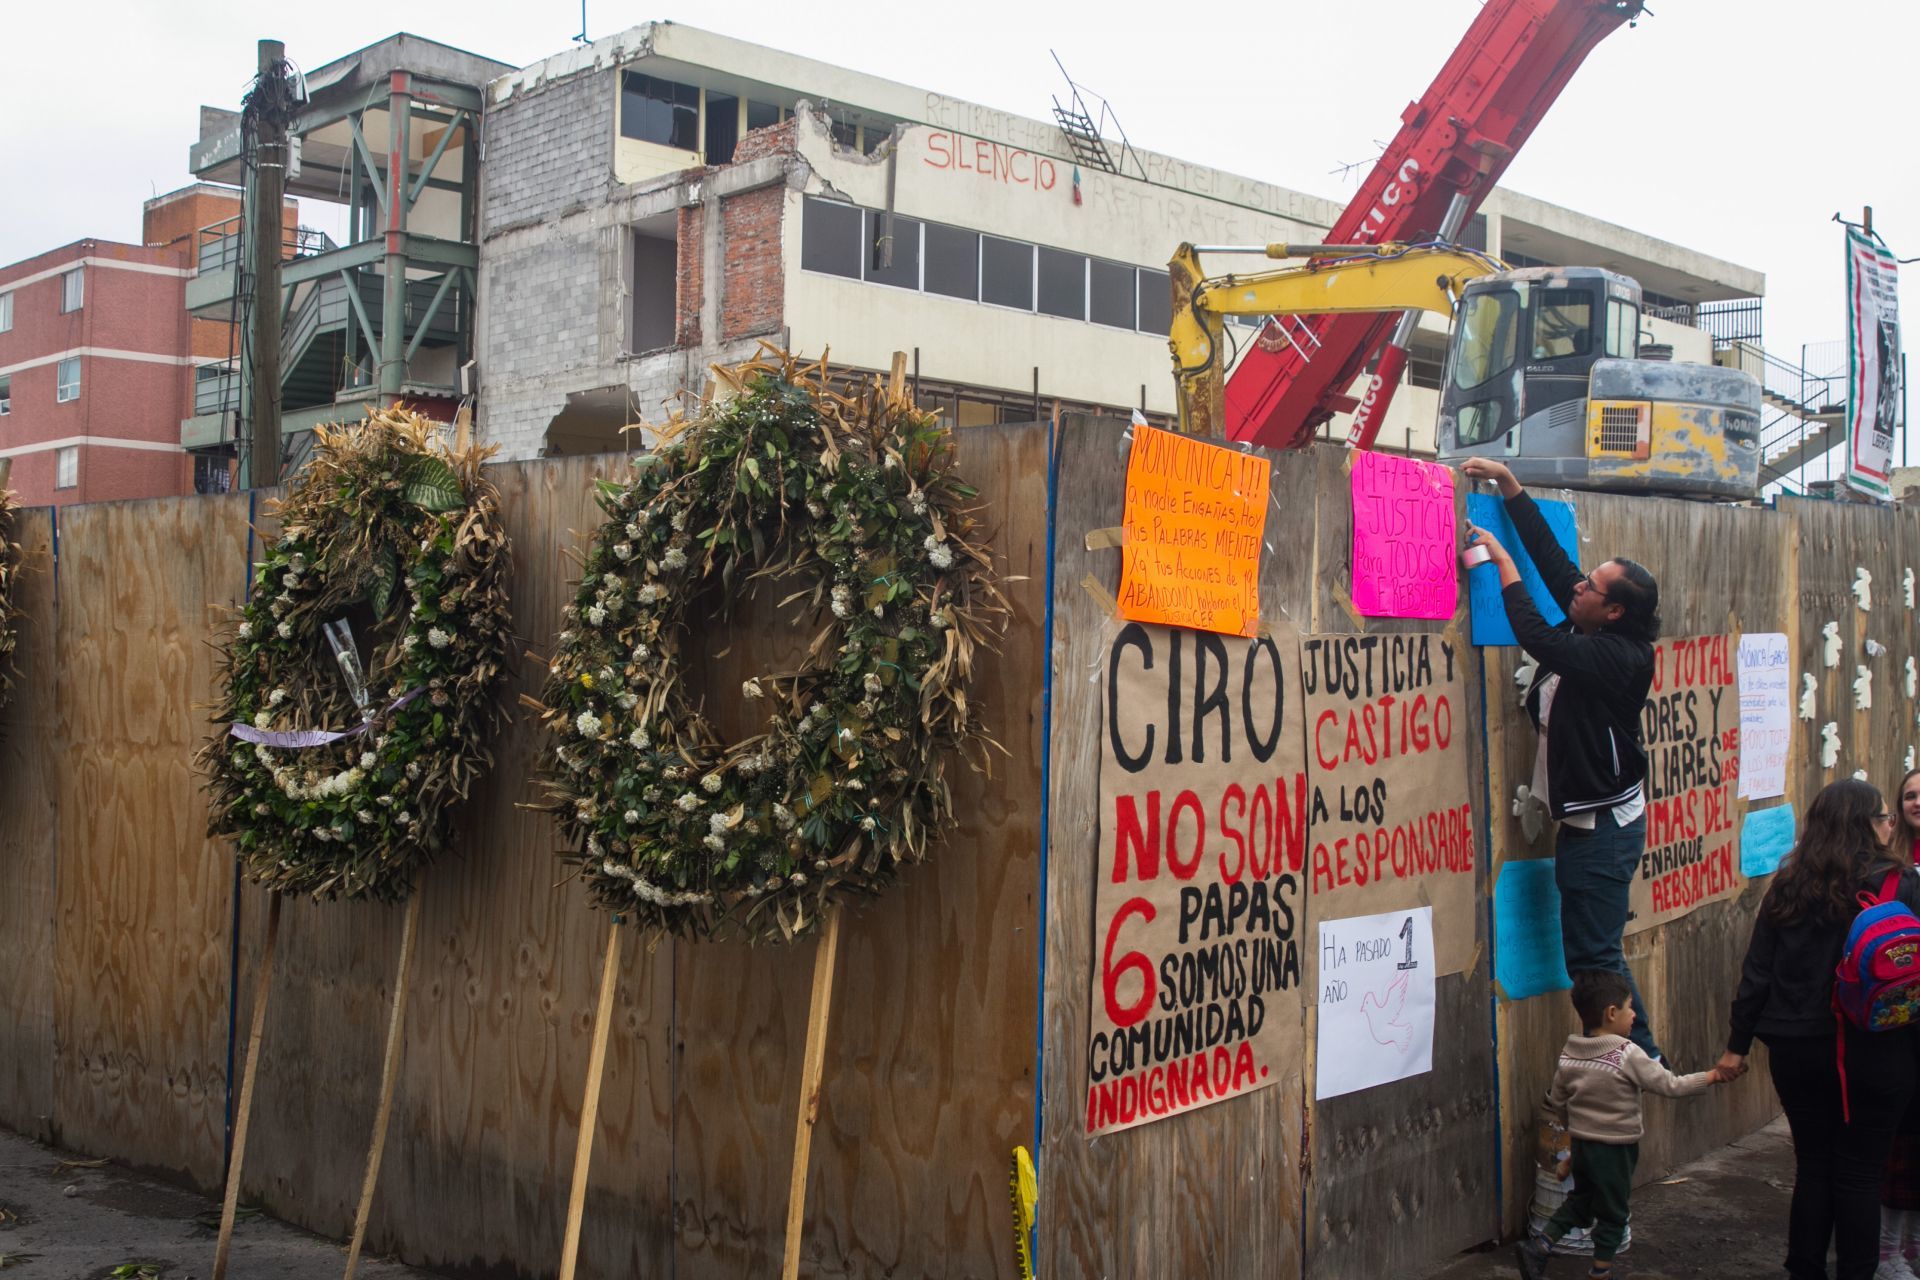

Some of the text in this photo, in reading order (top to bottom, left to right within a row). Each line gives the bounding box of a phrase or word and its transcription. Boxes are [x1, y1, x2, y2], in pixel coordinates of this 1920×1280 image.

[923, 132, 1057, 191] SILENCIO
[1128, 485, 1137, 505] a
[1144, 483, 1177, 514] nadie
[1367, 494, 1453, 541] JUSTICIA
[1127, 508, 1263, 561] tus PALABRAS MIENTEN
[1355, 535, 1383, 573] Para
[1385, 540, 1440, 584] TODOS
[1155, 549, 1174, 577] tus
[1175, 551, 1221, 586] ACCIONES
[1226, 561, 1238, 587] de
[1122, 579, 1195, 613] ABANDONO
[1304, 635, 1454, 700] JUSTICIA Y
[1672, 632, 1734, 689] TOTAL
[1108, 622, 1284, 774] CIRO
[1709, 687, 1724, 735] Y
[1315, 694, 1451, 771] CASTIGO
[1723, 729, 1738, 751] DE
[1721, 757, 1738, 783] LAS
[1311, 777, 1387, 826] A LOS
[1704, 785, 1732, 837] DEL
[1112, 773, 1306, 886] NO SON
[1642, 835, 1704, 881] ENRIQUE
[1652, 840, 1738, 914] REBSAMEN.
[1103, 897, 1157, 1028] 6
[1356, 938, 1391, 963] PASADO
[1397, 916, 1418, 972] 1
[1159, 937, 1300, 1012] SOMOS UNA
[1323, 980, 1348, 1005] AÑO
[1090, 994, 1265, 1083] COMUNIDAD
[1086, 1040, 1269, 1134] INDIGNADA.
